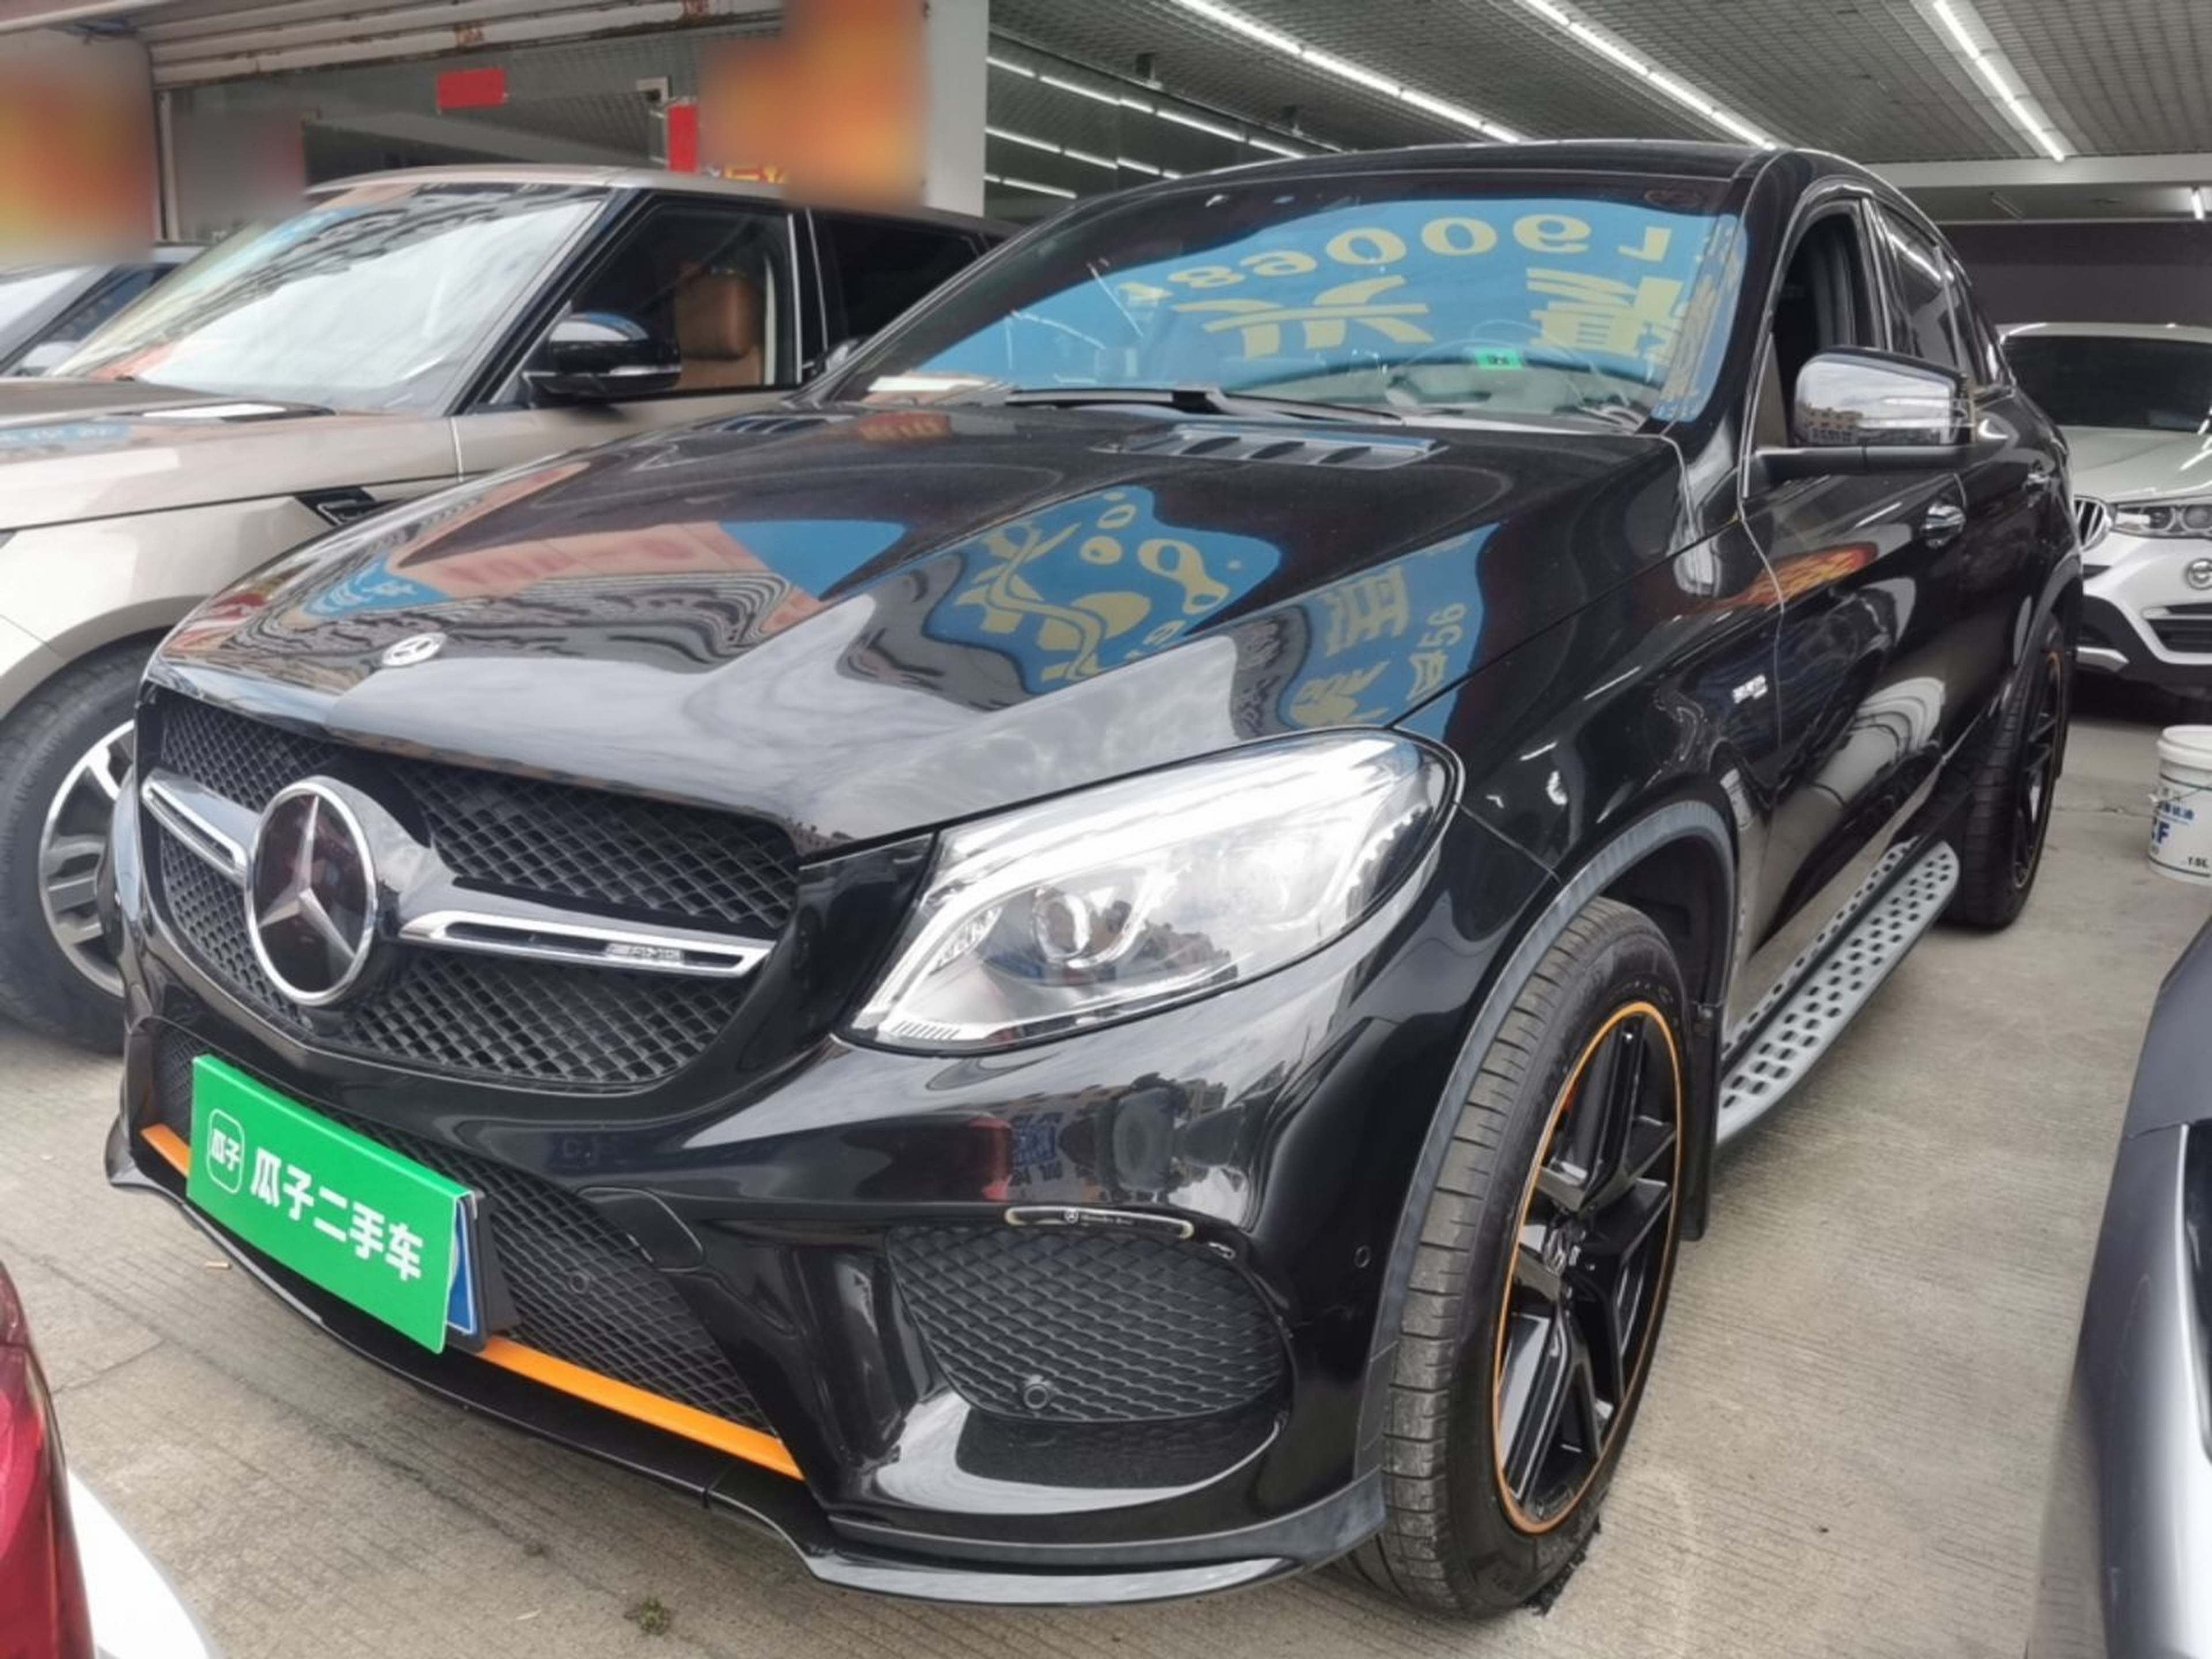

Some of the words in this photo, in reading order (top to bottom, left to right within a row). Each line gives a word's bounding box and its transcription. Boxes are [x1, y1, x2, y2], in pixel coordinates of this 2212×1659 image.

[210, 1129, 241, 1172] 瓜子
[251, 1147, 424, 1281] 瓜子二手车
